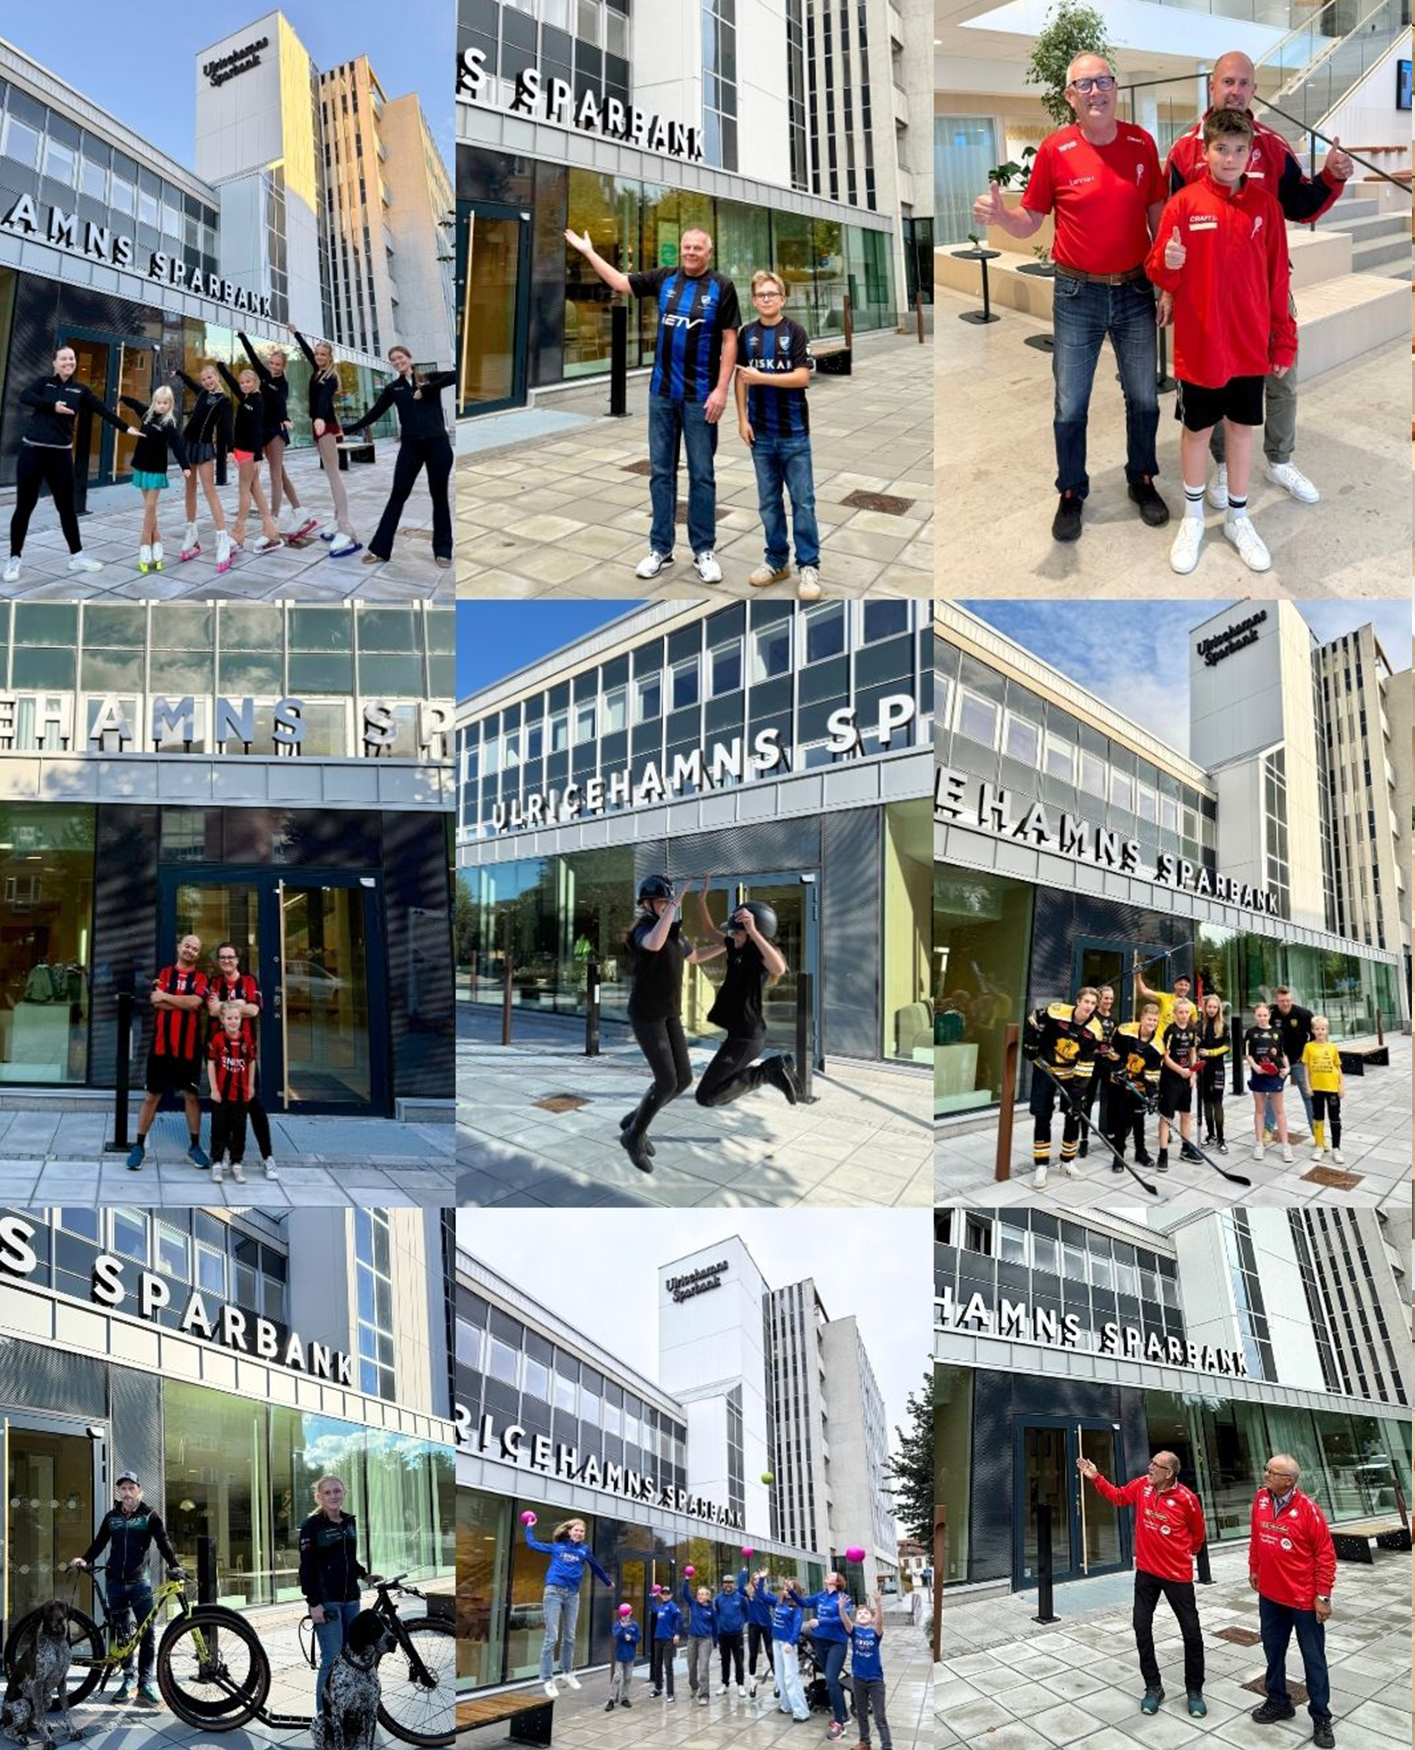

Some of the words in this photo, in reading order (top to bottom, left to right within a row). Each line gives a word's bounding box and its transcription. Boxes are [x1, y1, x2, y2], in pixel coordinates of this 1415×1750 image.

[463, 47, 487, 91] S
[519, 68, 706, 158] SPARBANK
[151, 250, 272, 317] SPARBANK
[492, 728, 782, 829] ULRICEHAMNS
[826, 694, 916, 754] SP
[936, 766, 1142, 867] EHAMNS
[1160, 854, 1280, 914] SPARBANK
[93, 1254, 352, 1386] SPARBANK
[1101, 1321, 1248, 1374] SPARBANK
[665, 1484, 744, 1528] SPARBANK
